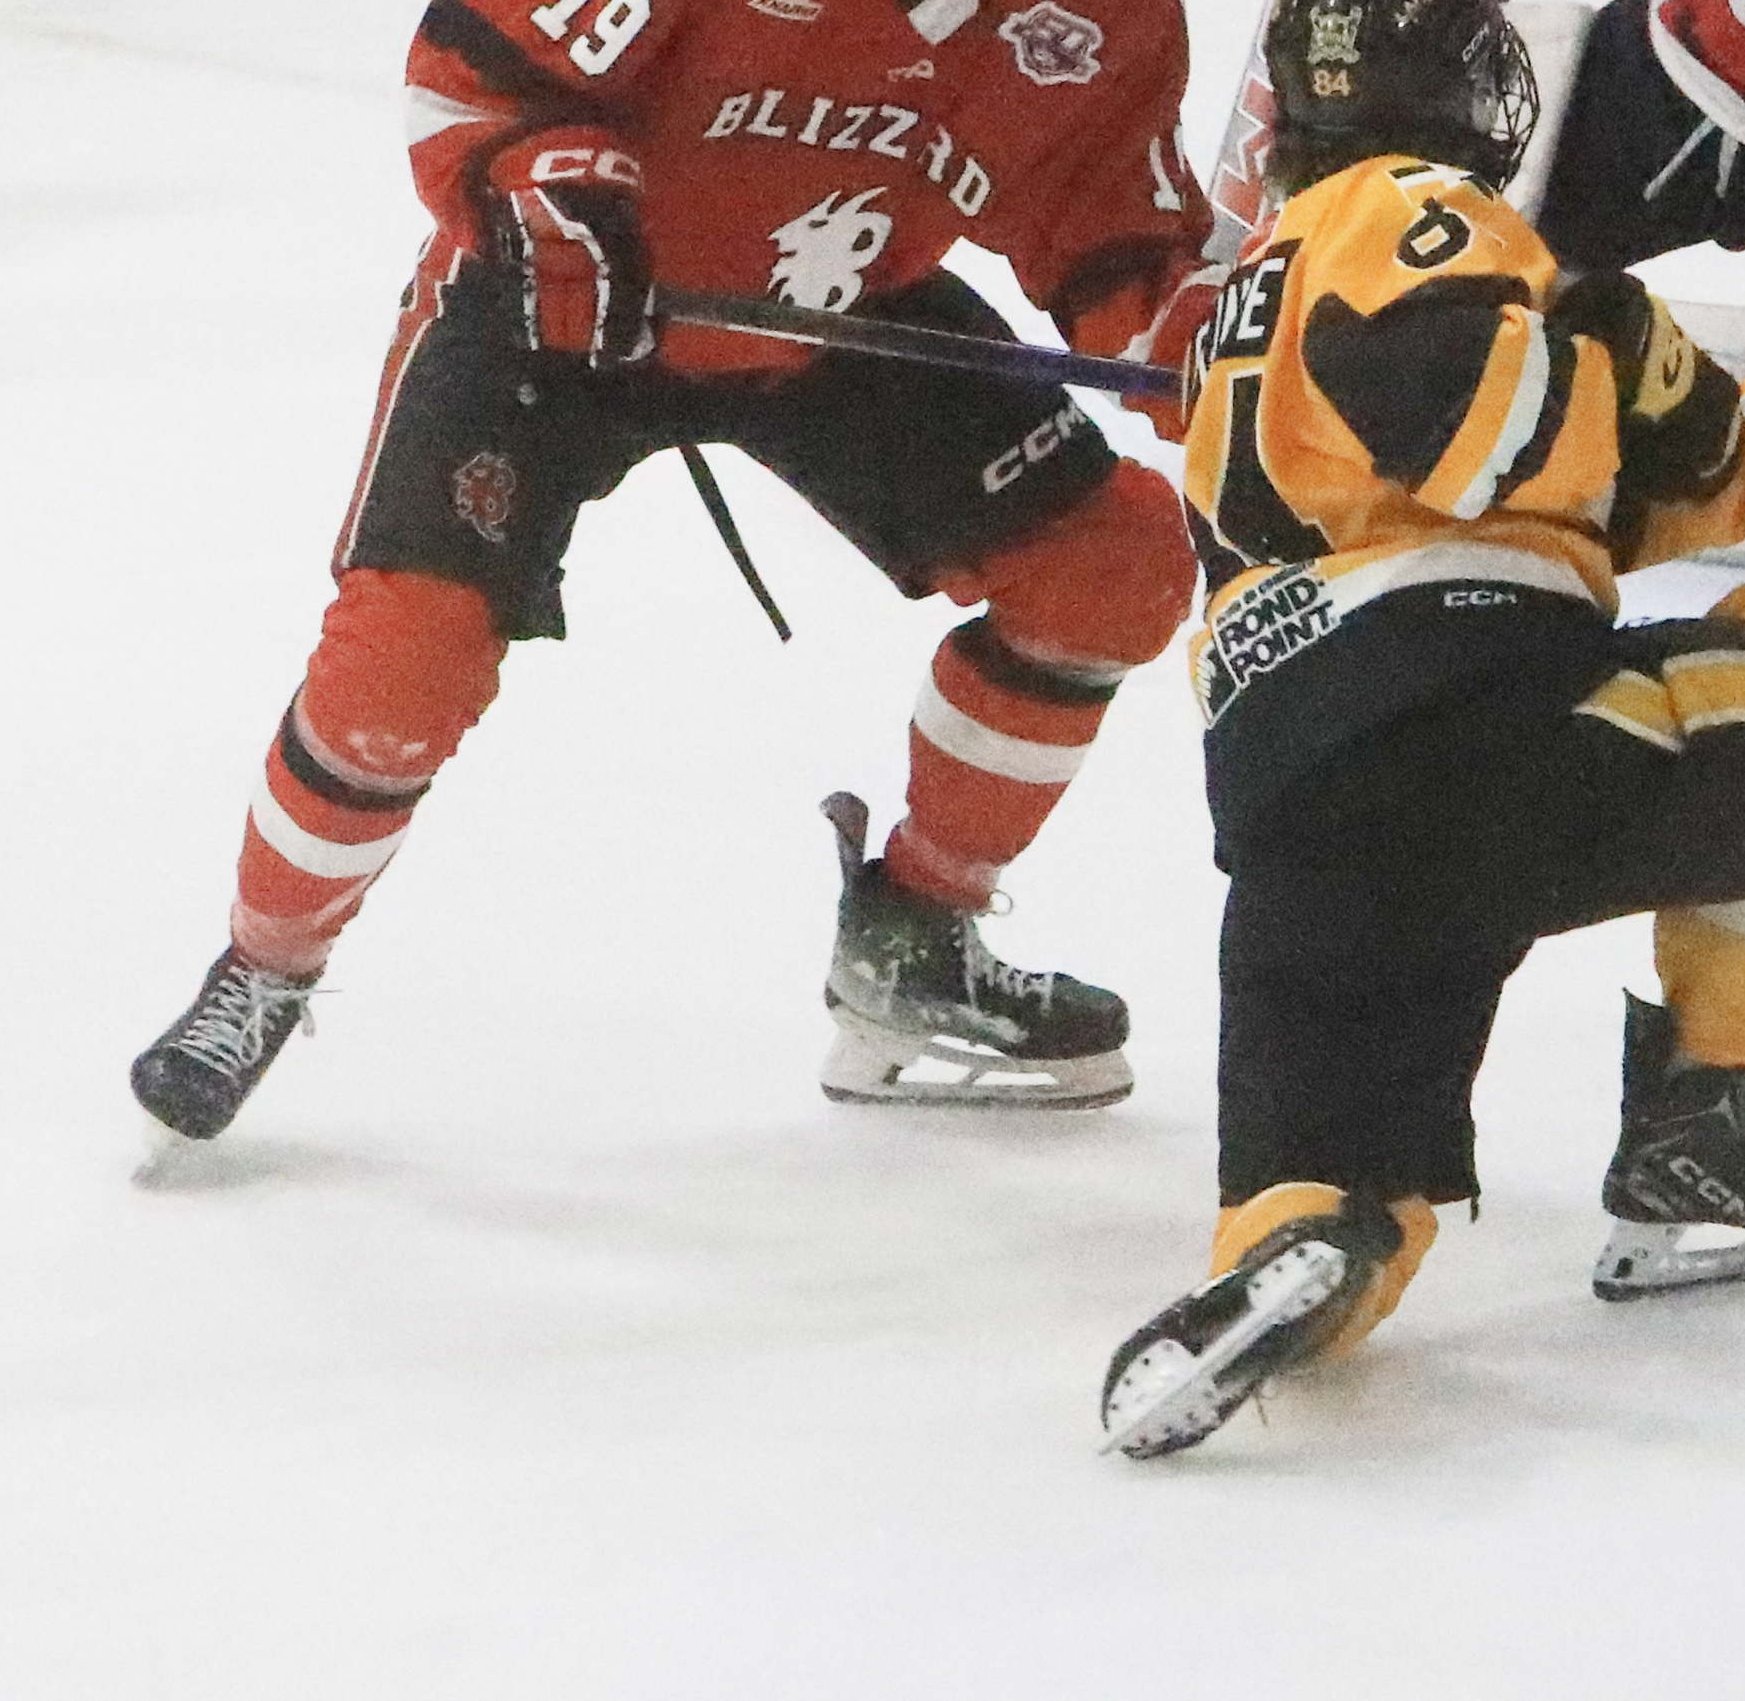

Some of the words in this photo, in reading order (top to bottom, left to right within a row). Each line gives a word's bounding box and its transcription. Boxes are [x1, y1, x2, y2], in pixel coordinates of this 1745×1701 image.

[1313, 69, 1352, 98] 84
[982, 402, 1087, 493] CCM
[1444, 589, 1518, 607] CCM
[1228, 599, 1335, 684] POINT
